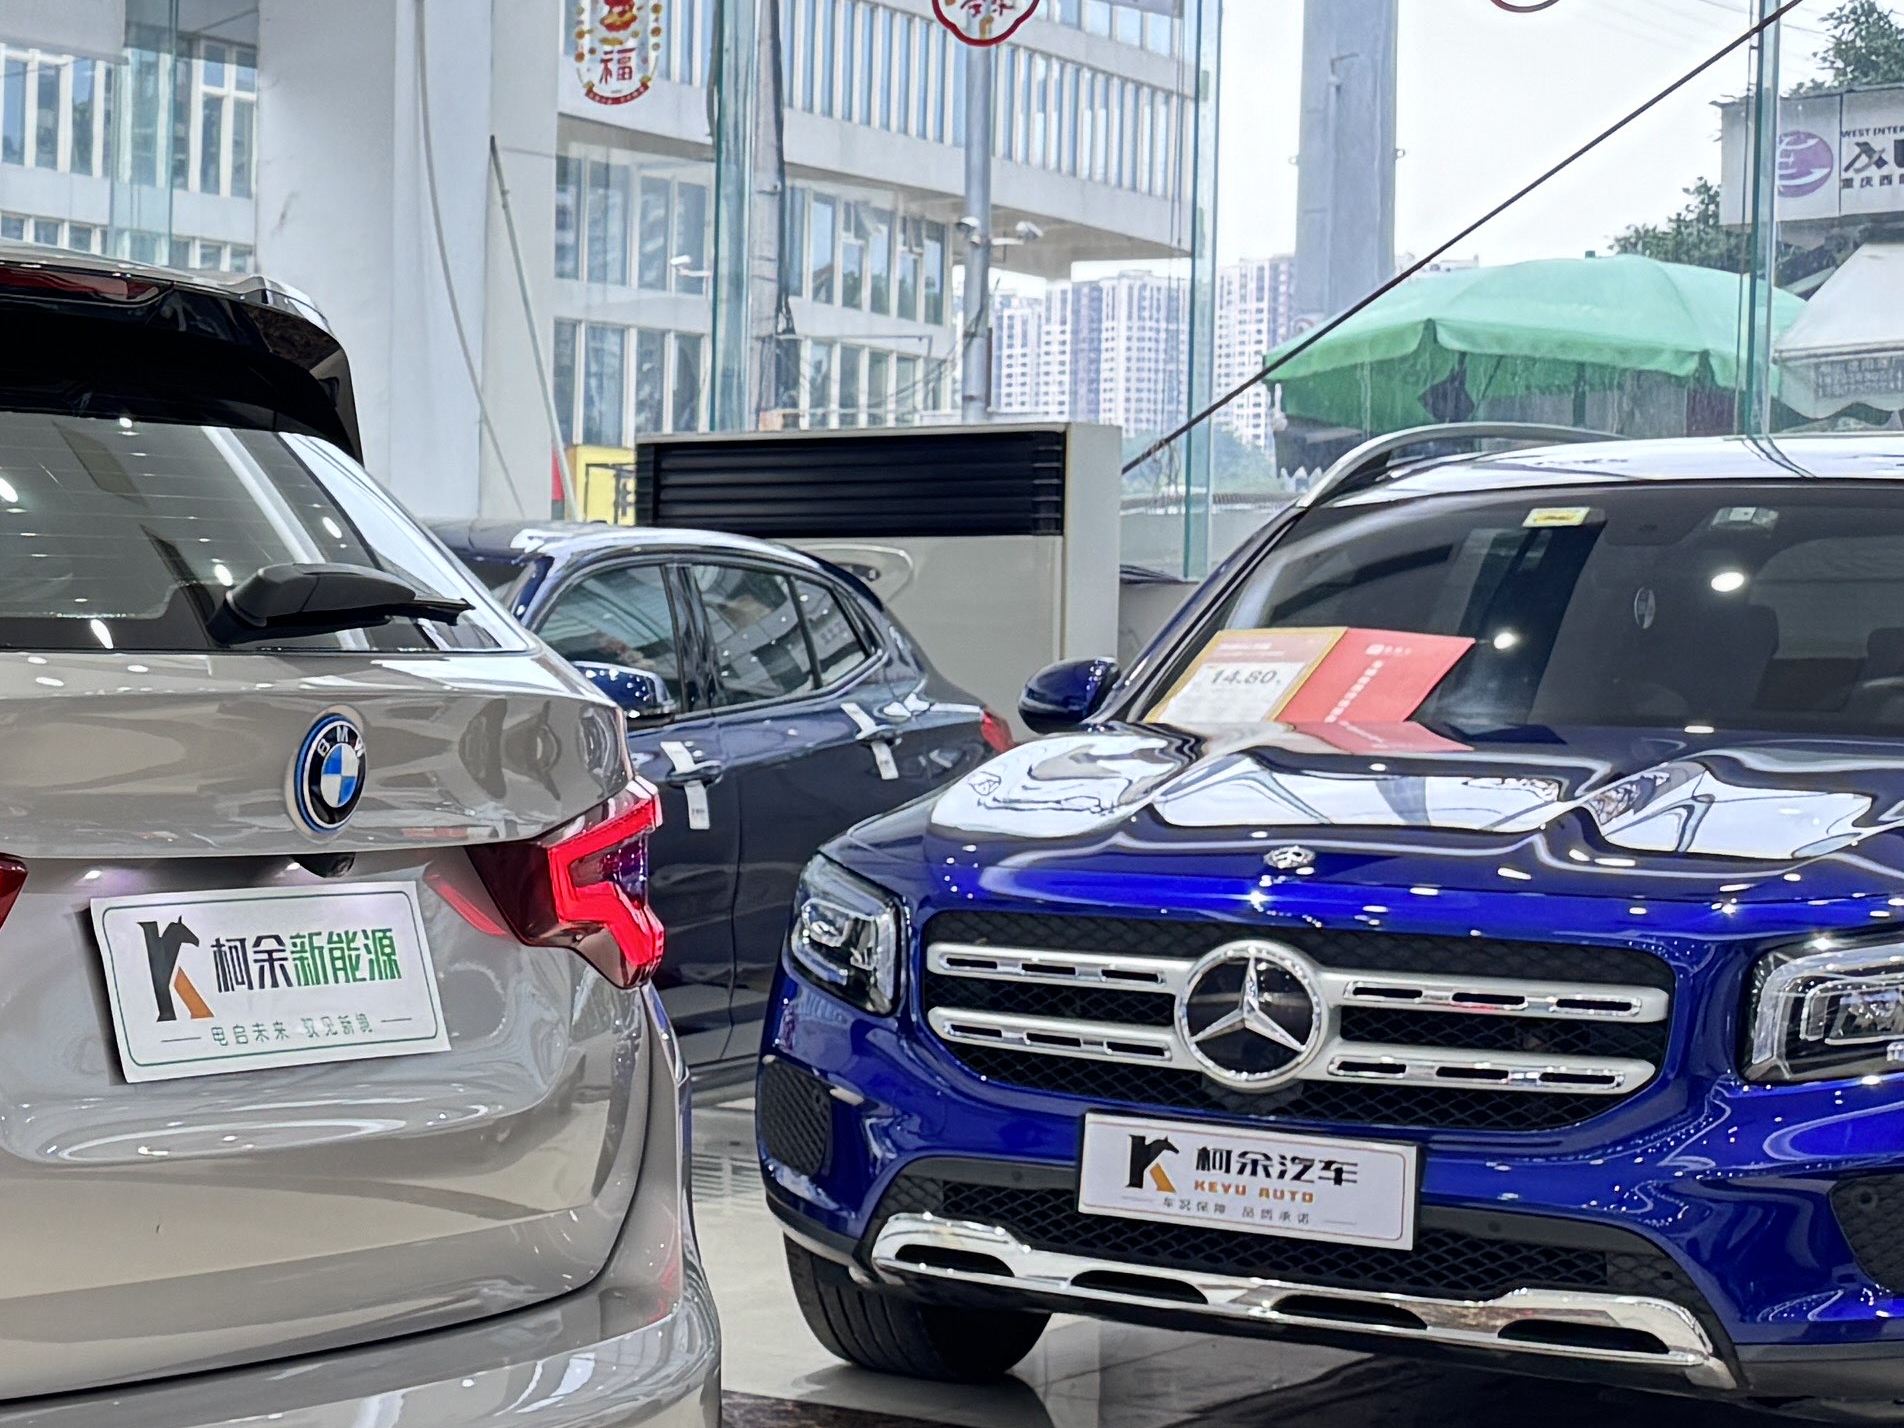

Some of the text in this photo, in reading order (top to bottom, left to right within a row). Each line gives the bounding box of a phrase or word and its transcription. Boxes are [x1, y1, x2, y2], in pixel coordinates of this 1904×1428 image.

[599, 46, 636, 85] 福
[210, 926, 402, 994] 柯余新能源
[1195, 1145, 1359, 1187] 柯余汽车
[1194, 1179, 1315, 1204] KEYU AUTO
